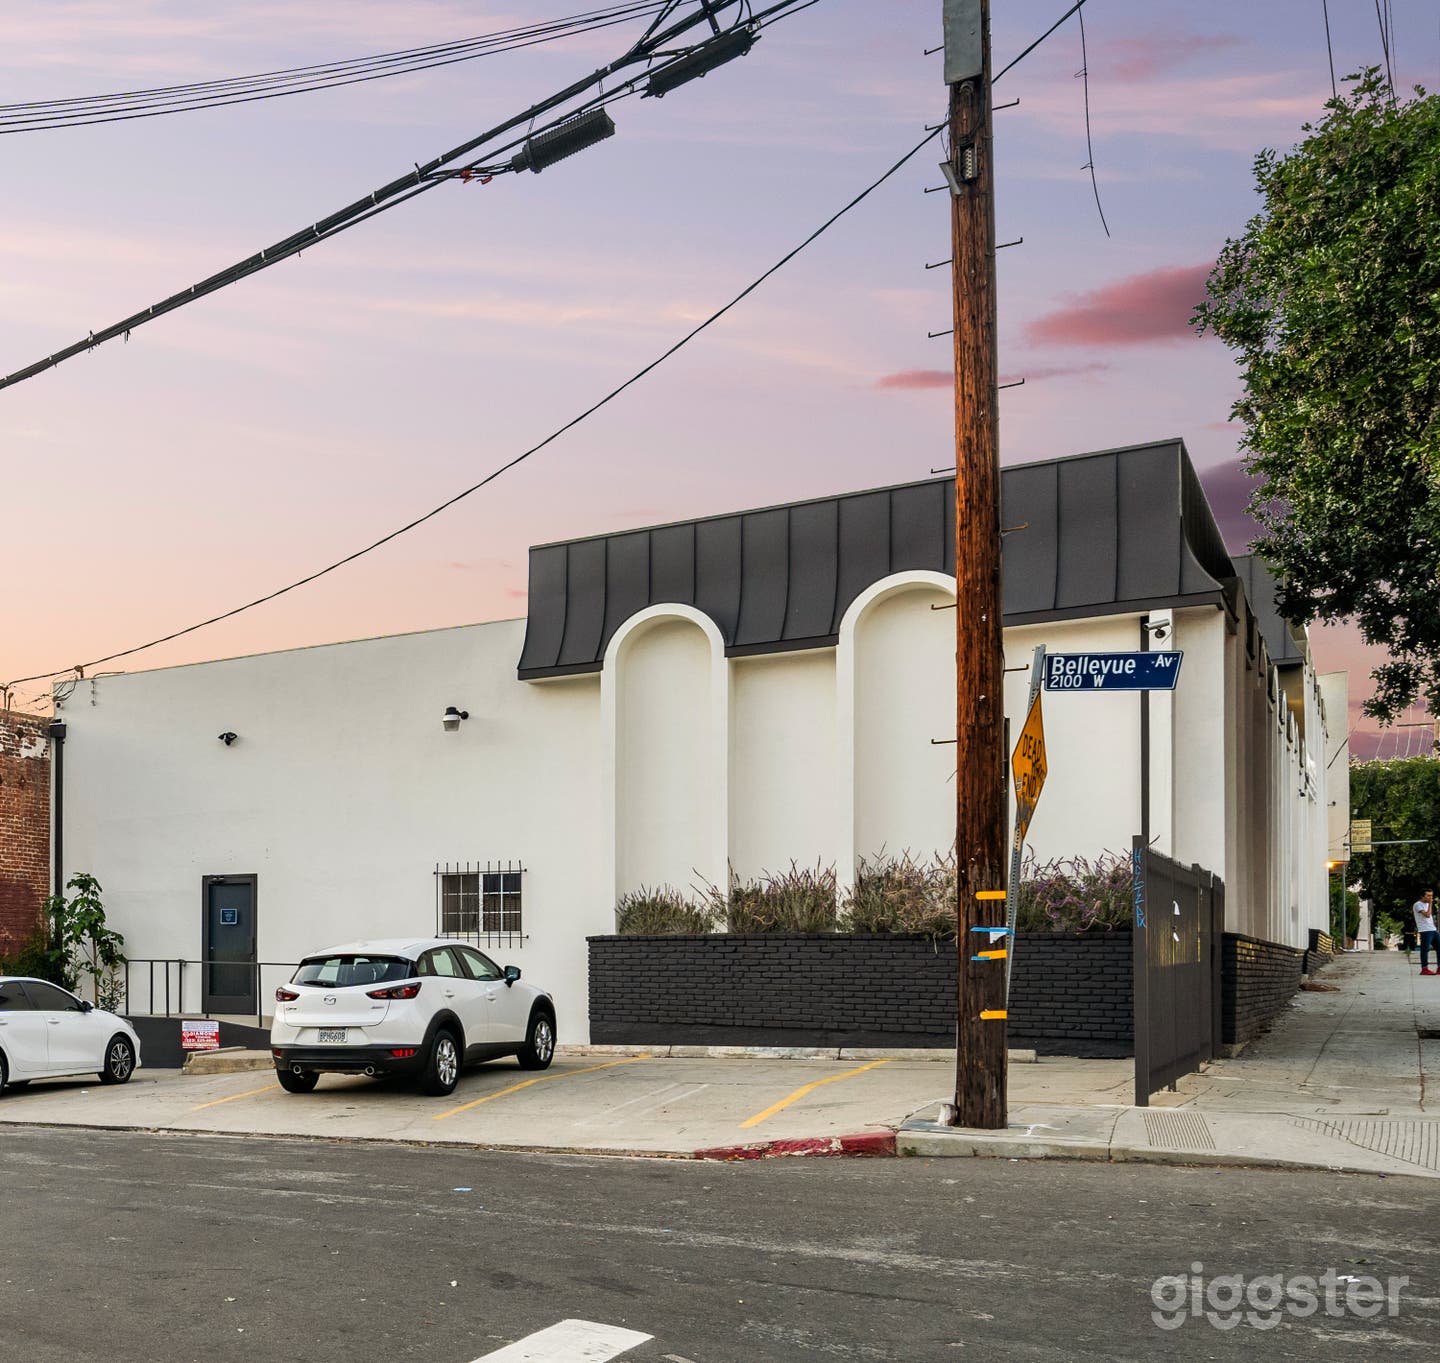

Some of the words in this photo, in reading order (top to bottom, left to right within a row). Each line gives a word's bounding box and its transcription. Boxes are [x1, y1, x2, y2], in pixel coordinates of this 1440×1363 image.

[1051, 656, 1136, 675] Bellevue
[1154, 655, 1173, 668] Av
[1049, 675, 1082, 688] 2100
[1093, 675, 1105, 688] W
[1022, 734, 1042, 762] DEAD
[1022, 773, 1037, 797] END
